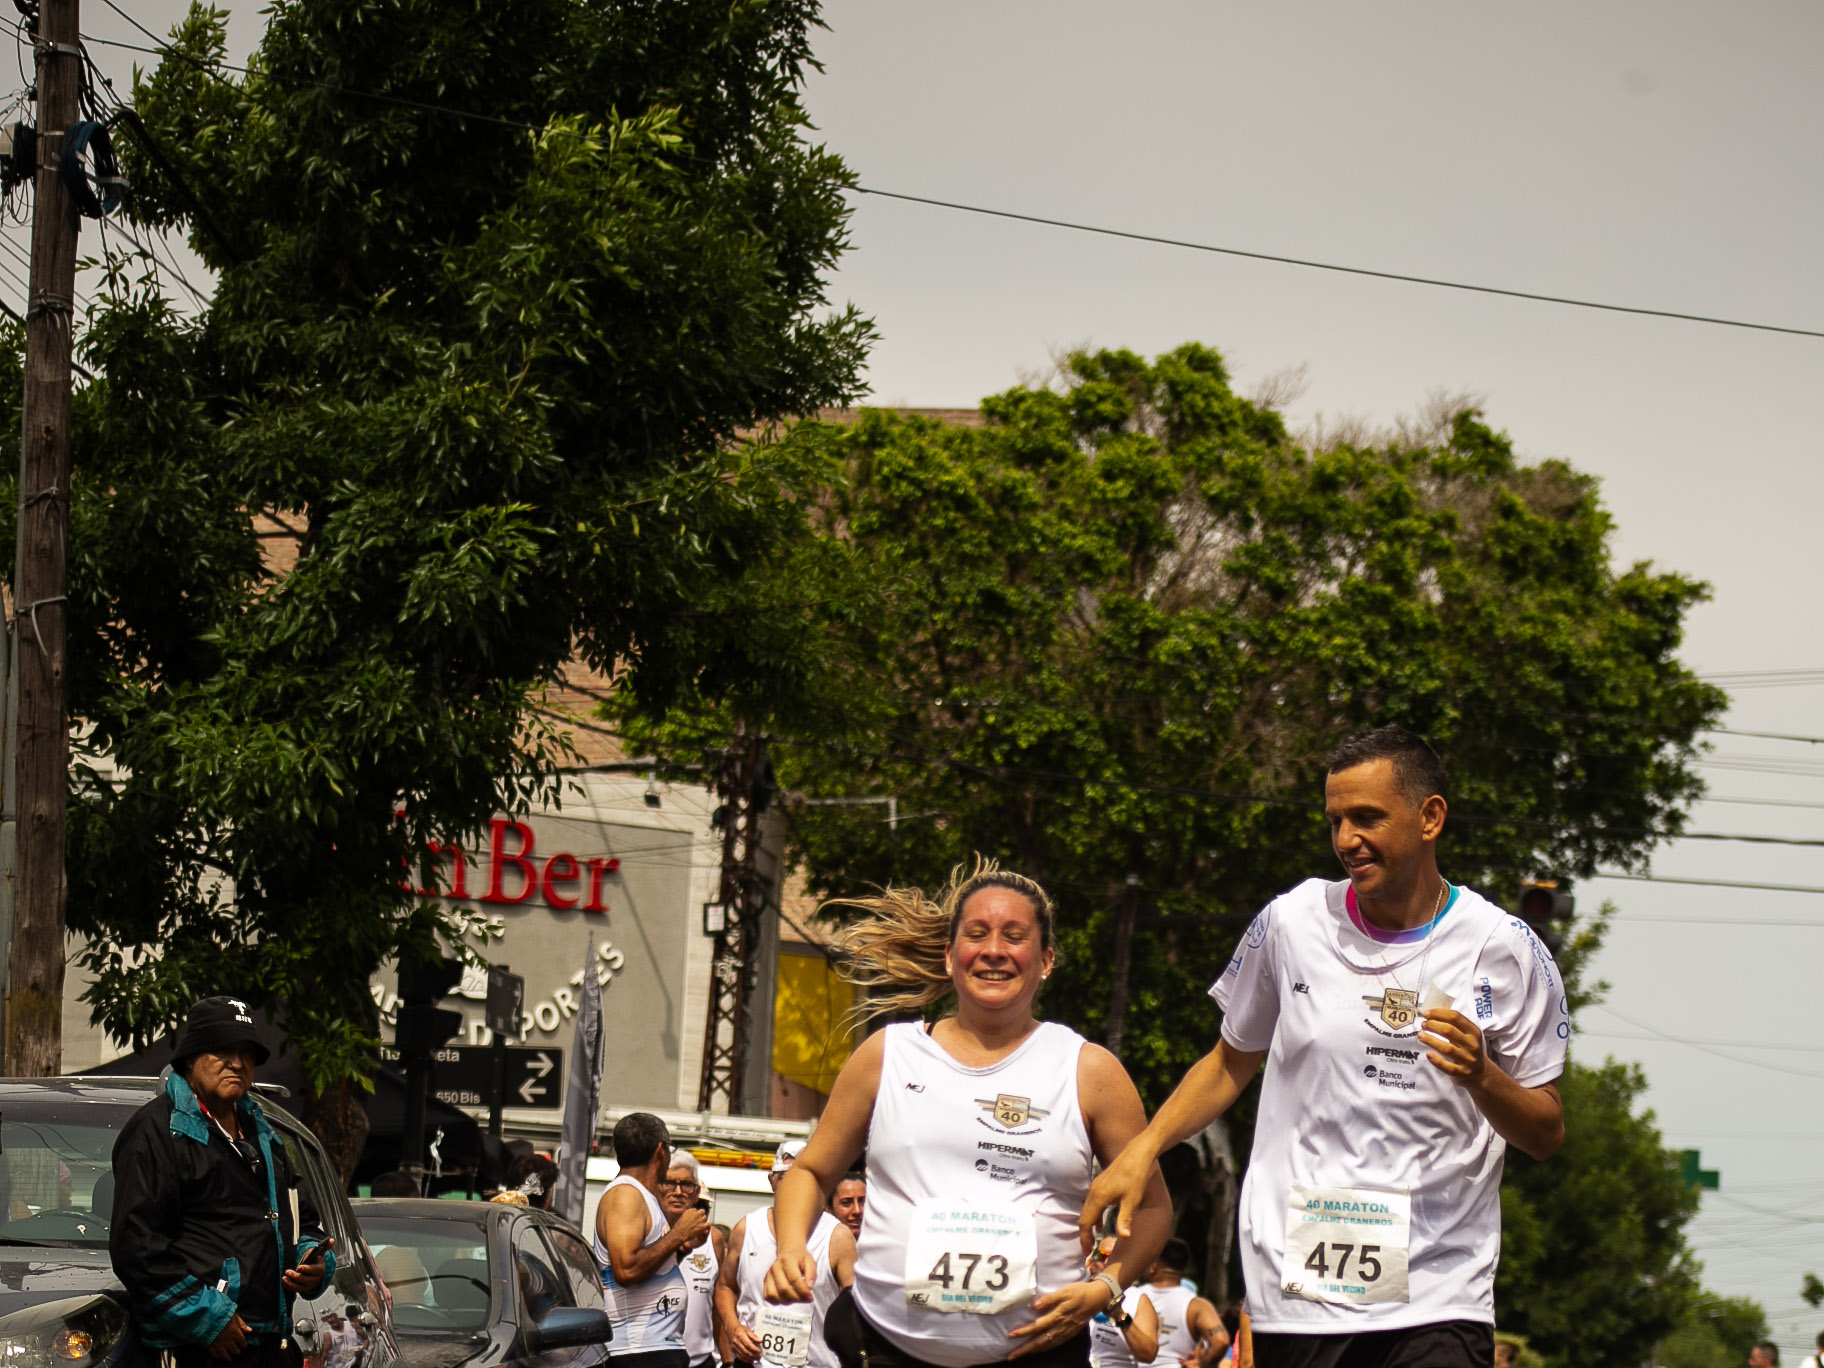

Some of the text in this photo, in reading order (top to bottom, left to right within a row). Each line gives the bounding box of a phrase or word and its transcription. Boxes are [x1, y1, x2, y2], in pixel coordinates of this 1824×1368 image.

[1480, 976, 1493, 1020] POWER
[1388, 1011, 1408, 1023] 40
[1364, 1018, 1419, 1039] EMPALME GRANE
[1379, 1069, 1403, 1080] Banco
[1378, 1078, 1416, 1091] Municipal
[460, 1090, 481, 1104] Bis
[1001, 1112, 1021, 1123] 40
[991, 1164, 1016, 1176] Banco
[1306, 1199, 1390, 1214] 40 MARATON
[950, 1211, 1017, 1225] MARATON
[1343, 1217, 1394, 1226] GRANEROS
[1304, 1241, 1383, 1283] 475
[927, 1251, 1010, 1292] 473
[1285, 1282, 1304, 1294] NEJ
[910, 1293, 930, 1304] NEJ
[761, 1333, 796, 1355] 681
